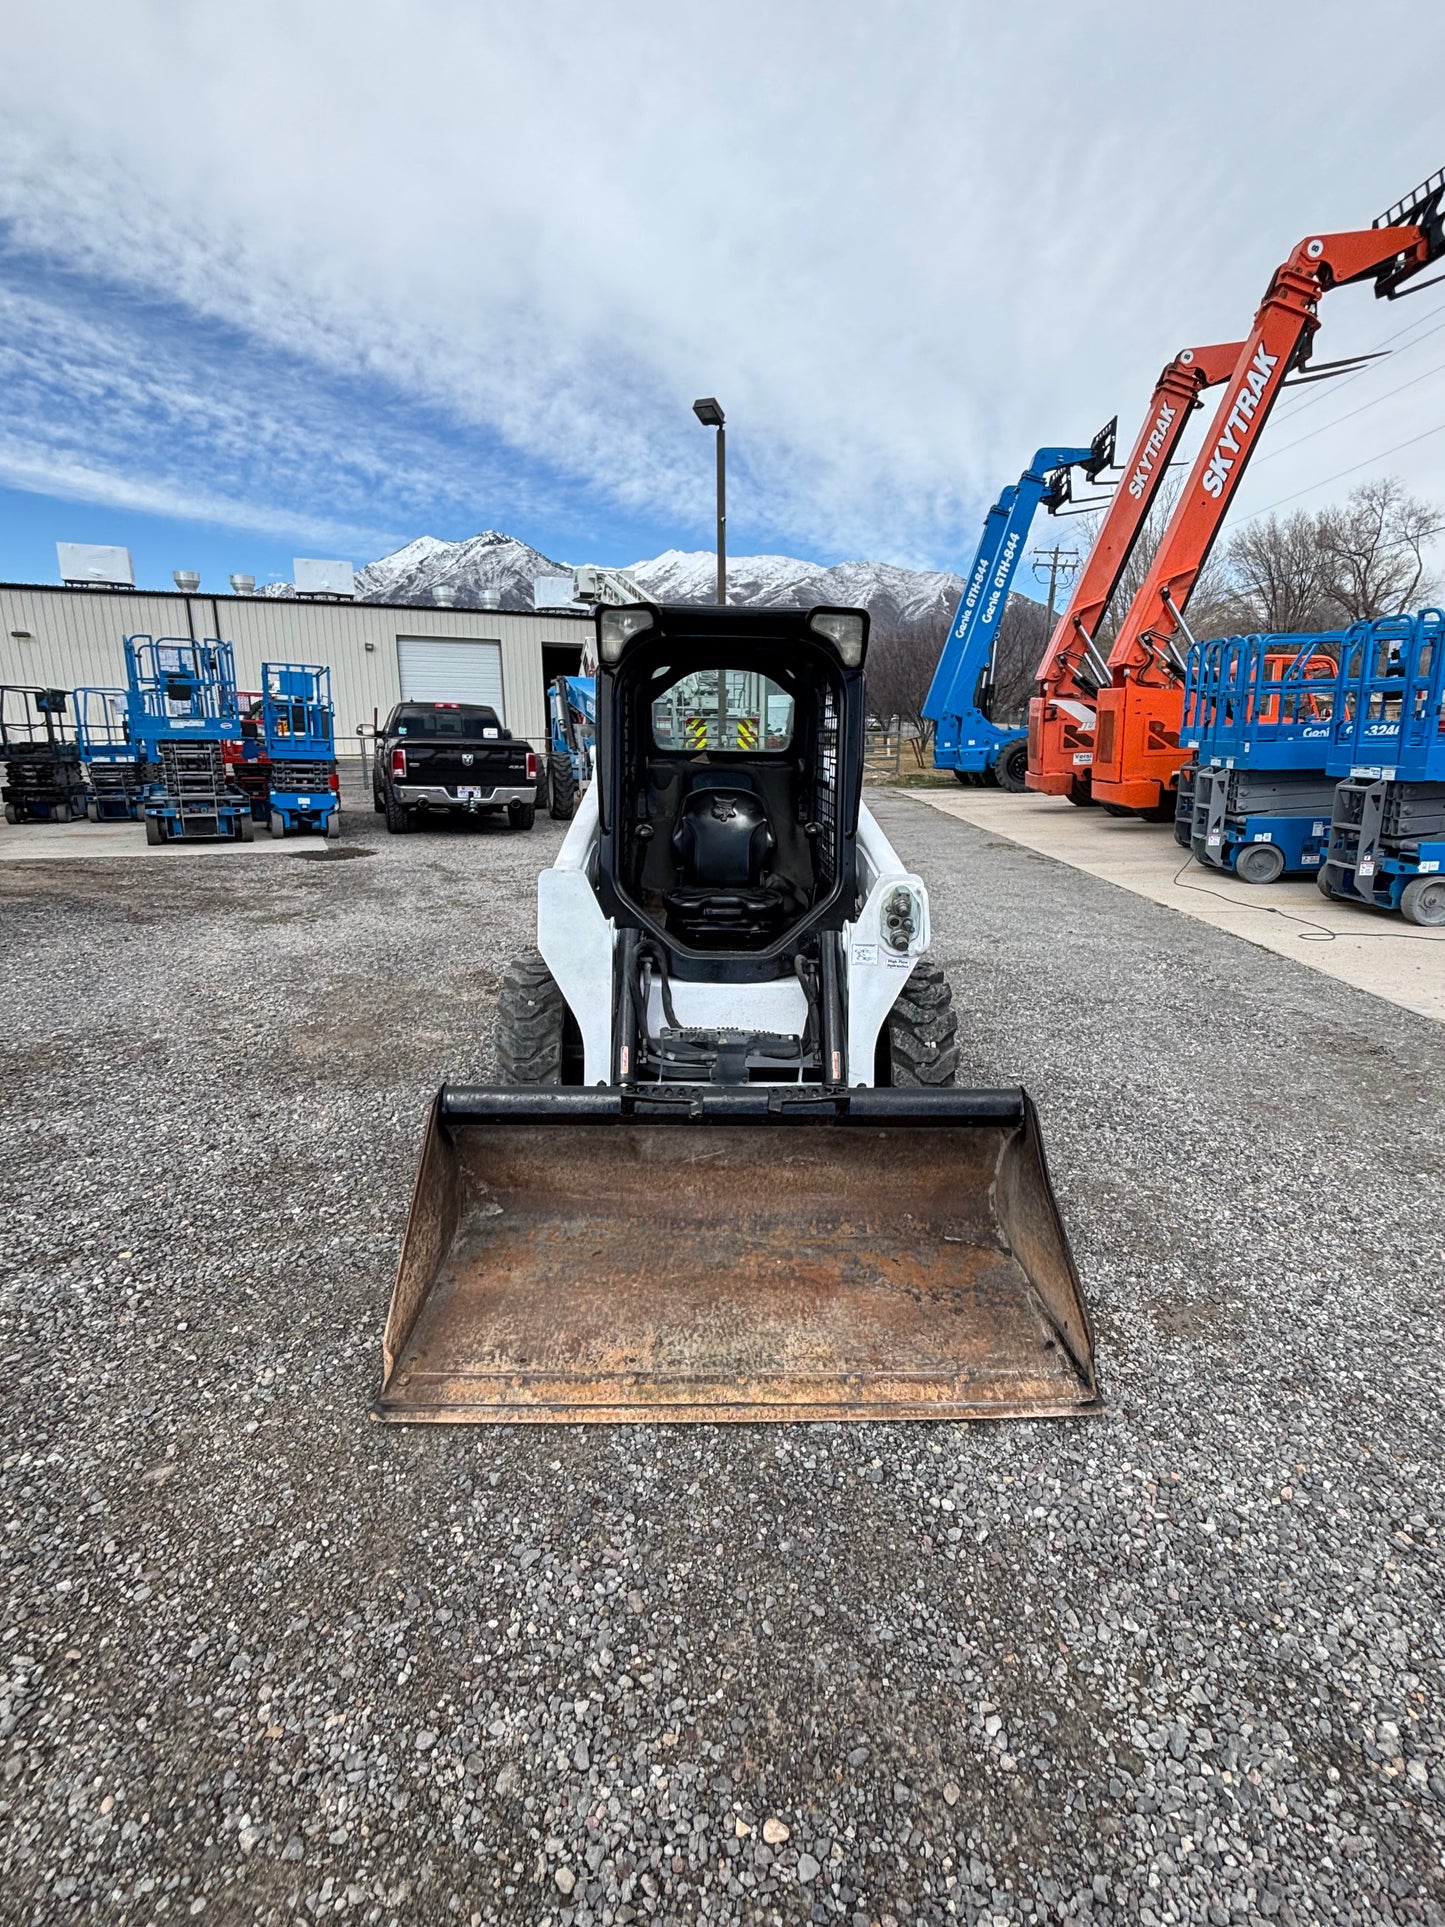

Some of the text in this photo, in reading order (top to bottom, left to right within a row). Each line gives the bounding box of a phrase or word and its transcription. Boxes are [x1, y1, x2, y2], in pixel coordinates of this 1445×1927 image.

[1129, 399, 1177, 499] SKYTRAK
[1202, 341, 1279, 498] SKYTRAK
[955, 558, 989, 638] Genie GTH-844
[982, 532, 1020, 623] Genie GTH-844
[1303, 727, 1330, 737] Geni
